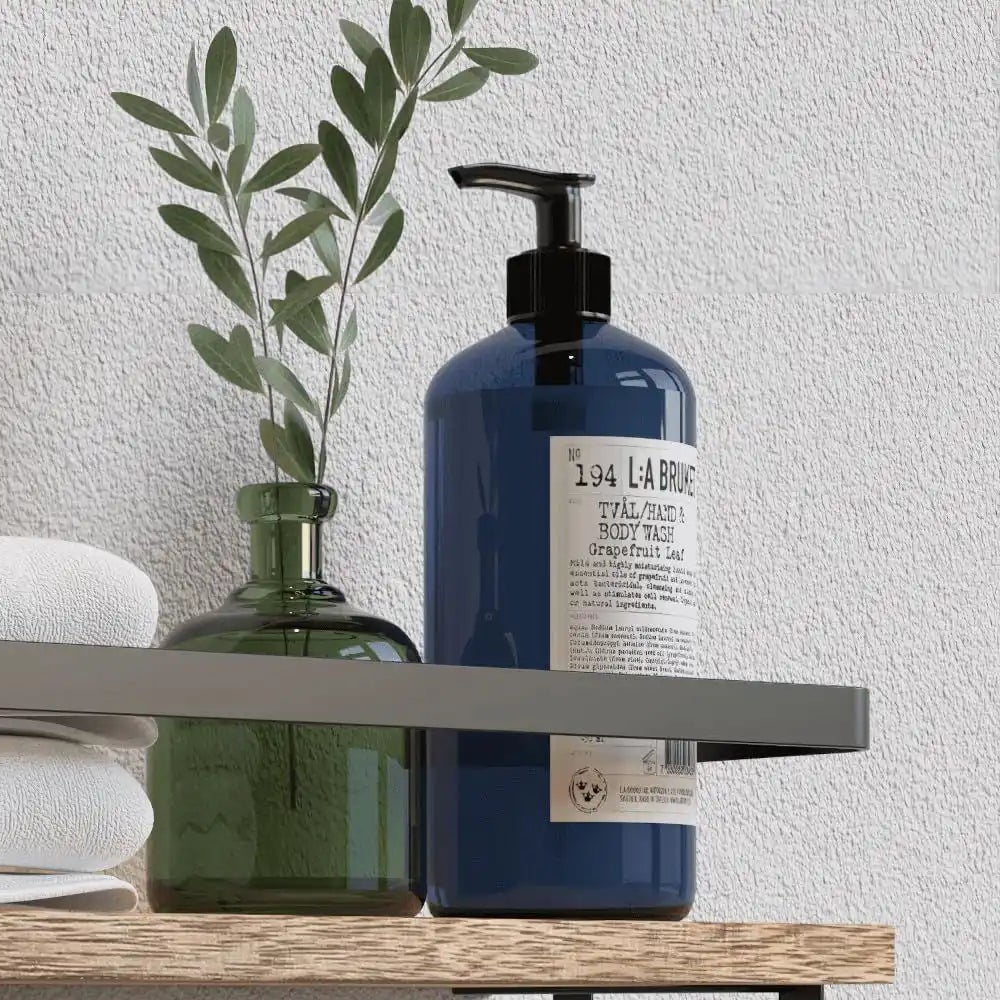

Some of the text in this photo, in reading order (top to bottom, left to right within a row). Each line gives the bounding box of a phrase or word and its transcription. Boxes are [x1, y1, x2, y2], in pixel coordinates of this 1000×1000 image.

[575, 463, 617, 487] 194
[628, 456, 655, 490] L:A
[598, 521, 675, 543] BODY WASH
[589, 543, 684, 561] Grapefruit Leaf
